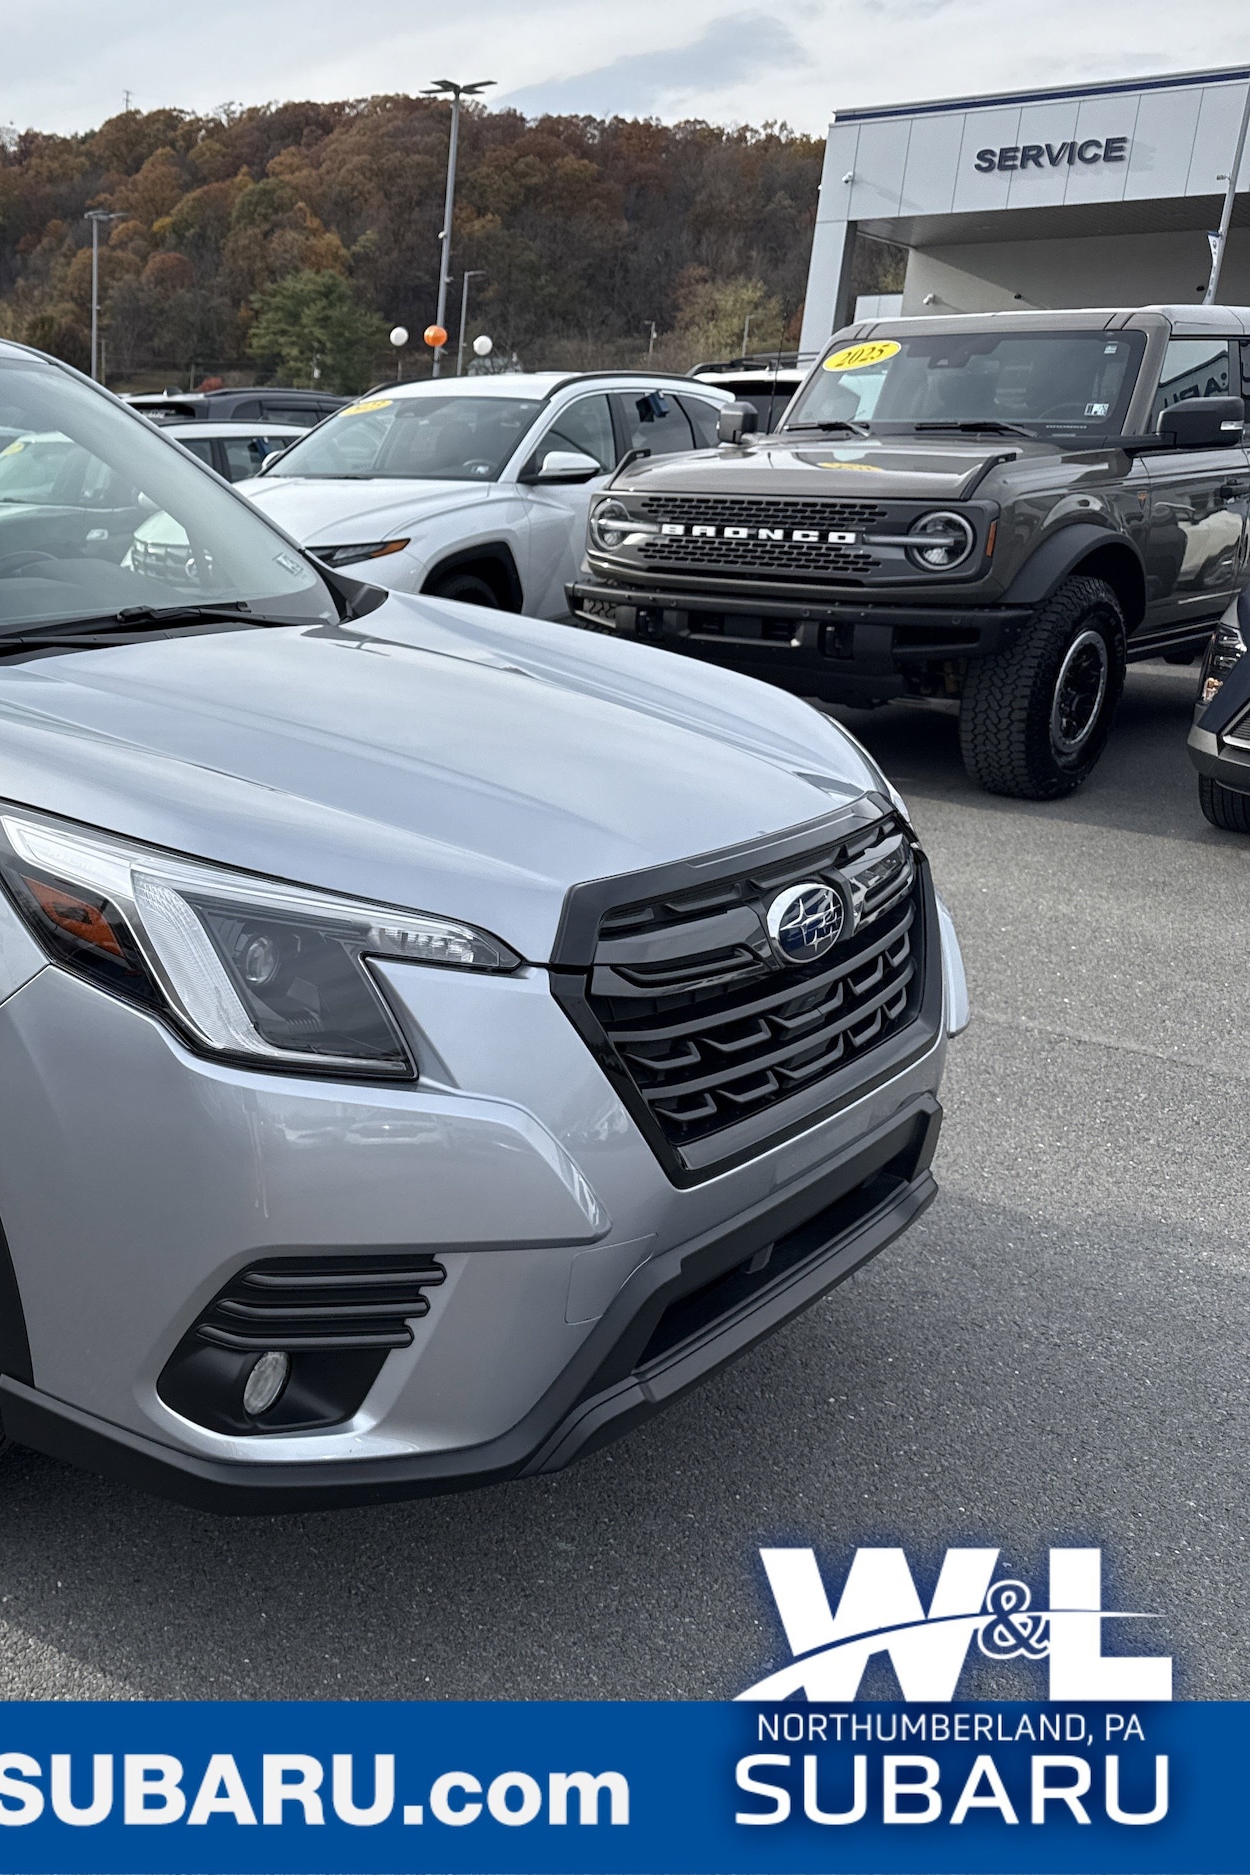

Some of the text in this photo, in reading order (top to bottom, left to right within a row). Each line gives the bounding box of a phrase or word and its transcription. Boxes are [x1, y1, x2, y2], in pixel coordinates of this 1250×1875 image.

[974, 136, 1128, 173] SERVICE
[834, 343, 891, 368] 2025
[661, 523, 857, 545] BRONCO
